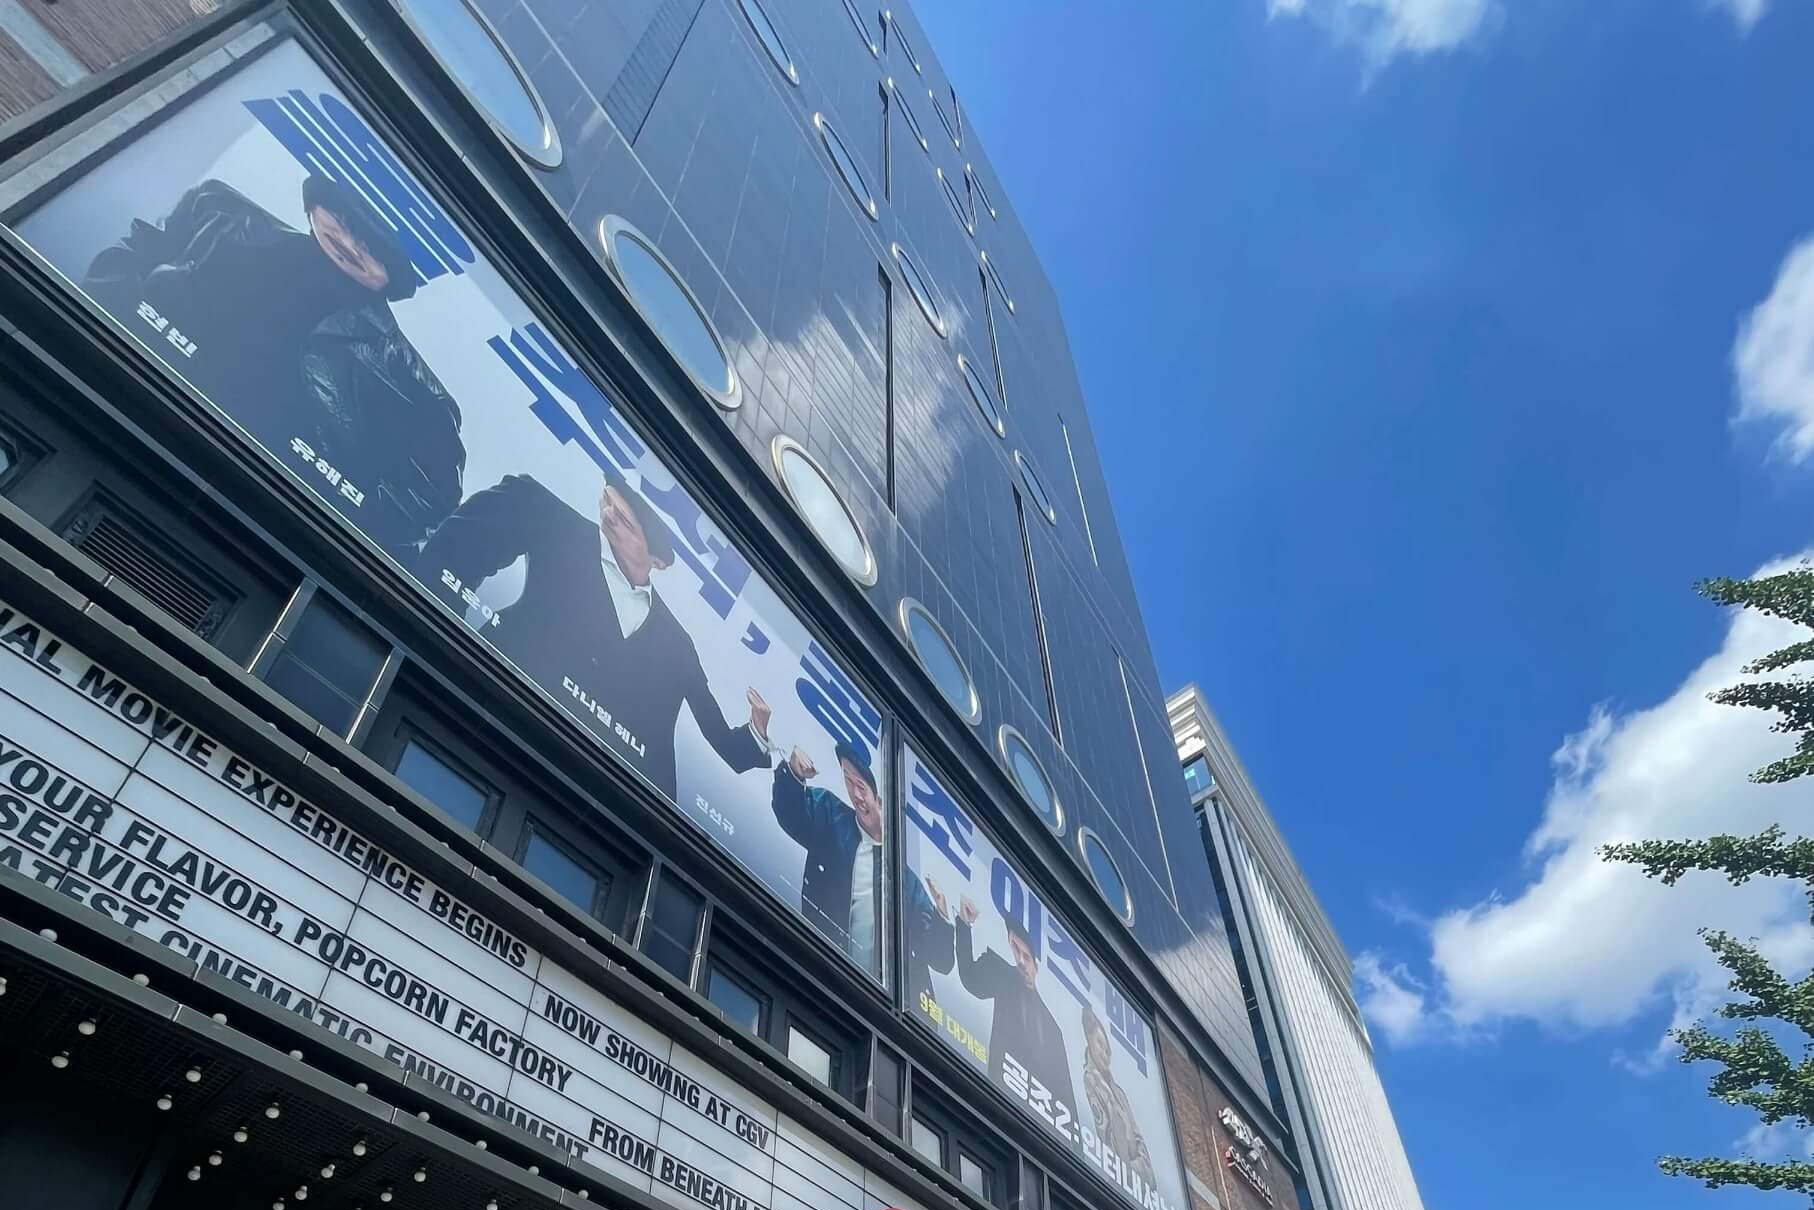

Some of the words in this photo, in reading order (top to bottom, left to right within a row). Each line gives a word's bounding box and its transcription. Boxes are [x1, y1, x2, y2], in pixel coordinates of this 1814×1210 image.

[137, 300, 198, 358] 현빈
[290, 437, 365, 508] 유해진
[440, 568, 501, 627] 임윤아
[563, 675, 613, 728] 다니엘
[614, 721, 646, 757] 헤니
[77, 664, 218, 768] MOVIE
[221, 755, 425, 903] EXPERIENCE
[428, 890, 528, 968] BEGINS
[696, 793, 736, 837] 진선규
[0, 793, 192, 922] SERVICE
[119, 819, 284, 936] FLAVOR,
[293, 916, 449, 1025] POPCORN
[454, 1008, 573, 1093] FACTORY
[919, 991, 944, 1024] 9월
[544, 994, 602, 1046] NOW
[605, 1033, 701, 1109] SHOWING
[704, 1097, 731, 1126] AT
[735, 1113, 769, 1150] CGV
[588, 1117, 655, 1173] FROM
